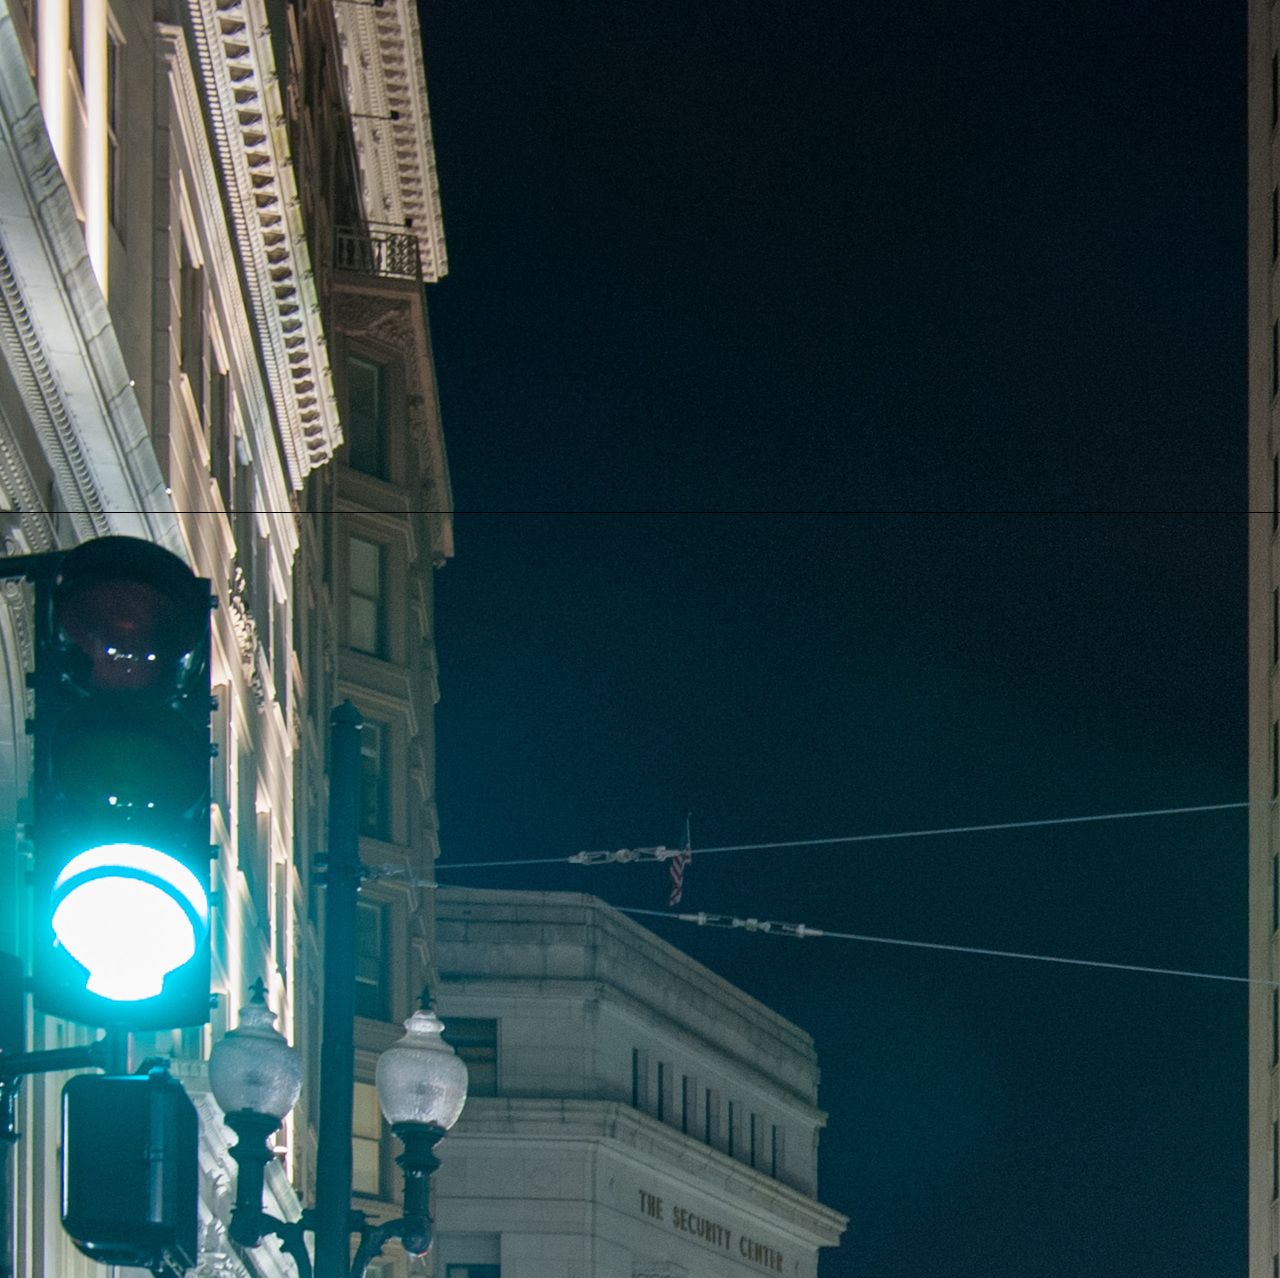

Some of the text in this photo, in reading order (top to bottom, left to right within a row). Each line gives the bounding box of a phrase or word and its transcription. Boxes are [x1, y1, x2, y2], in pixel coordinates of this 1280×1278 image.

[638, 1189, 783, 1274] THE SECURITY CENTER
